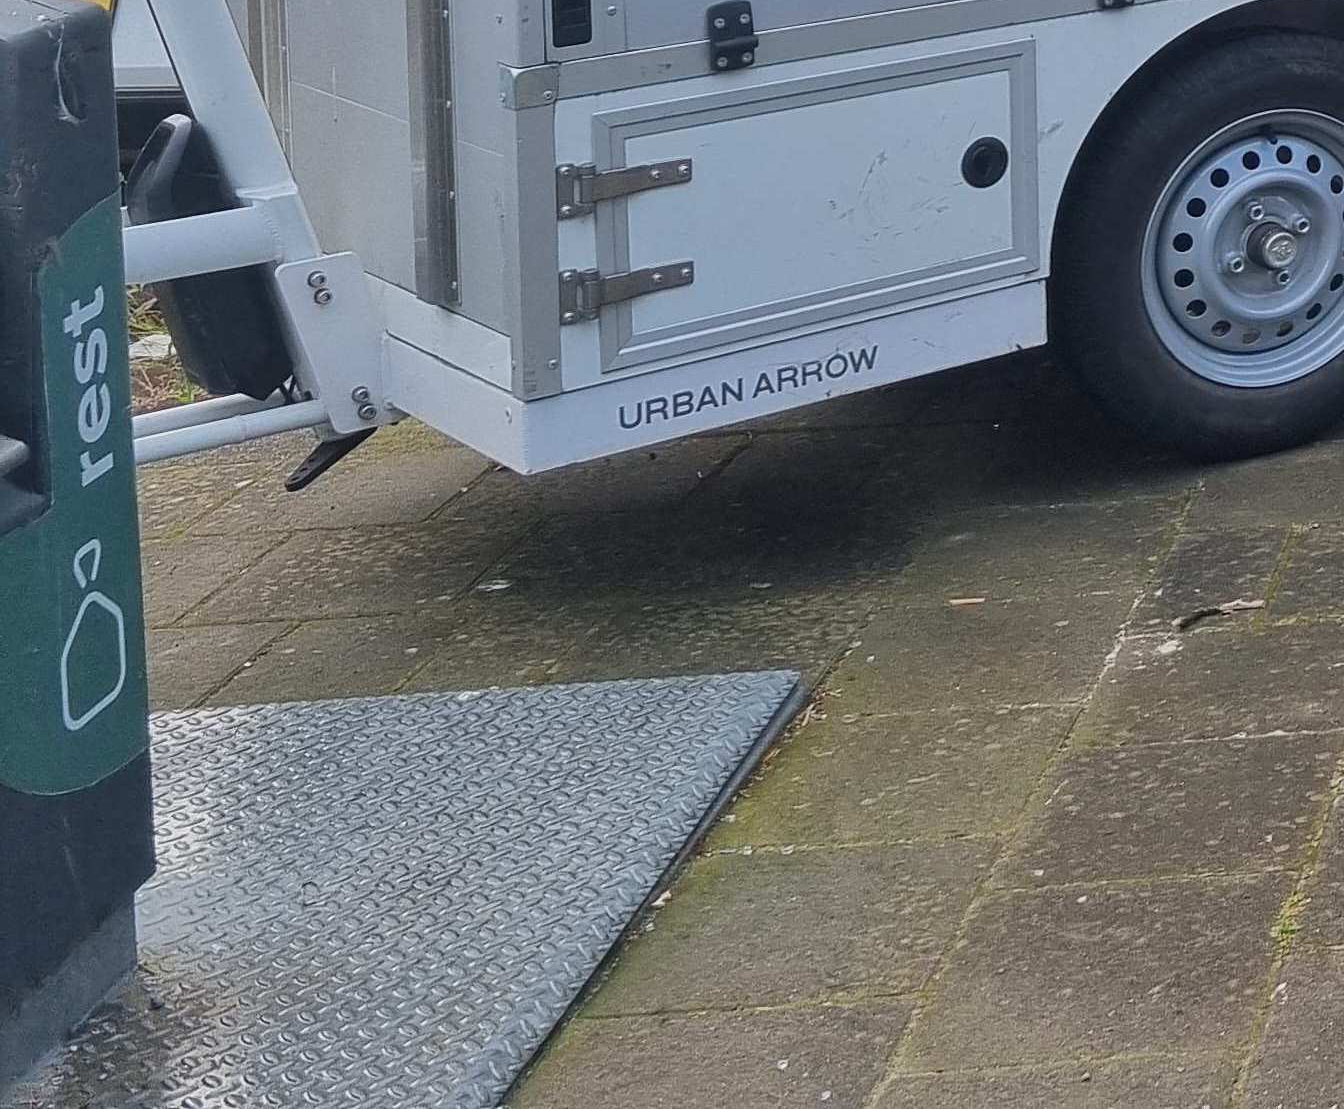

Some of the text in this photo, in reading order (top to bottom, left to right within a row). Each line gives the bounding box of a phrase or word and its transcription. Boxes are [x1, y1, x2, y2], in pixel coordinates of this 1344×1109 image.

[63, 285, 114, 487] rest
[618, 345, 879, 430] URBAN ARROW
